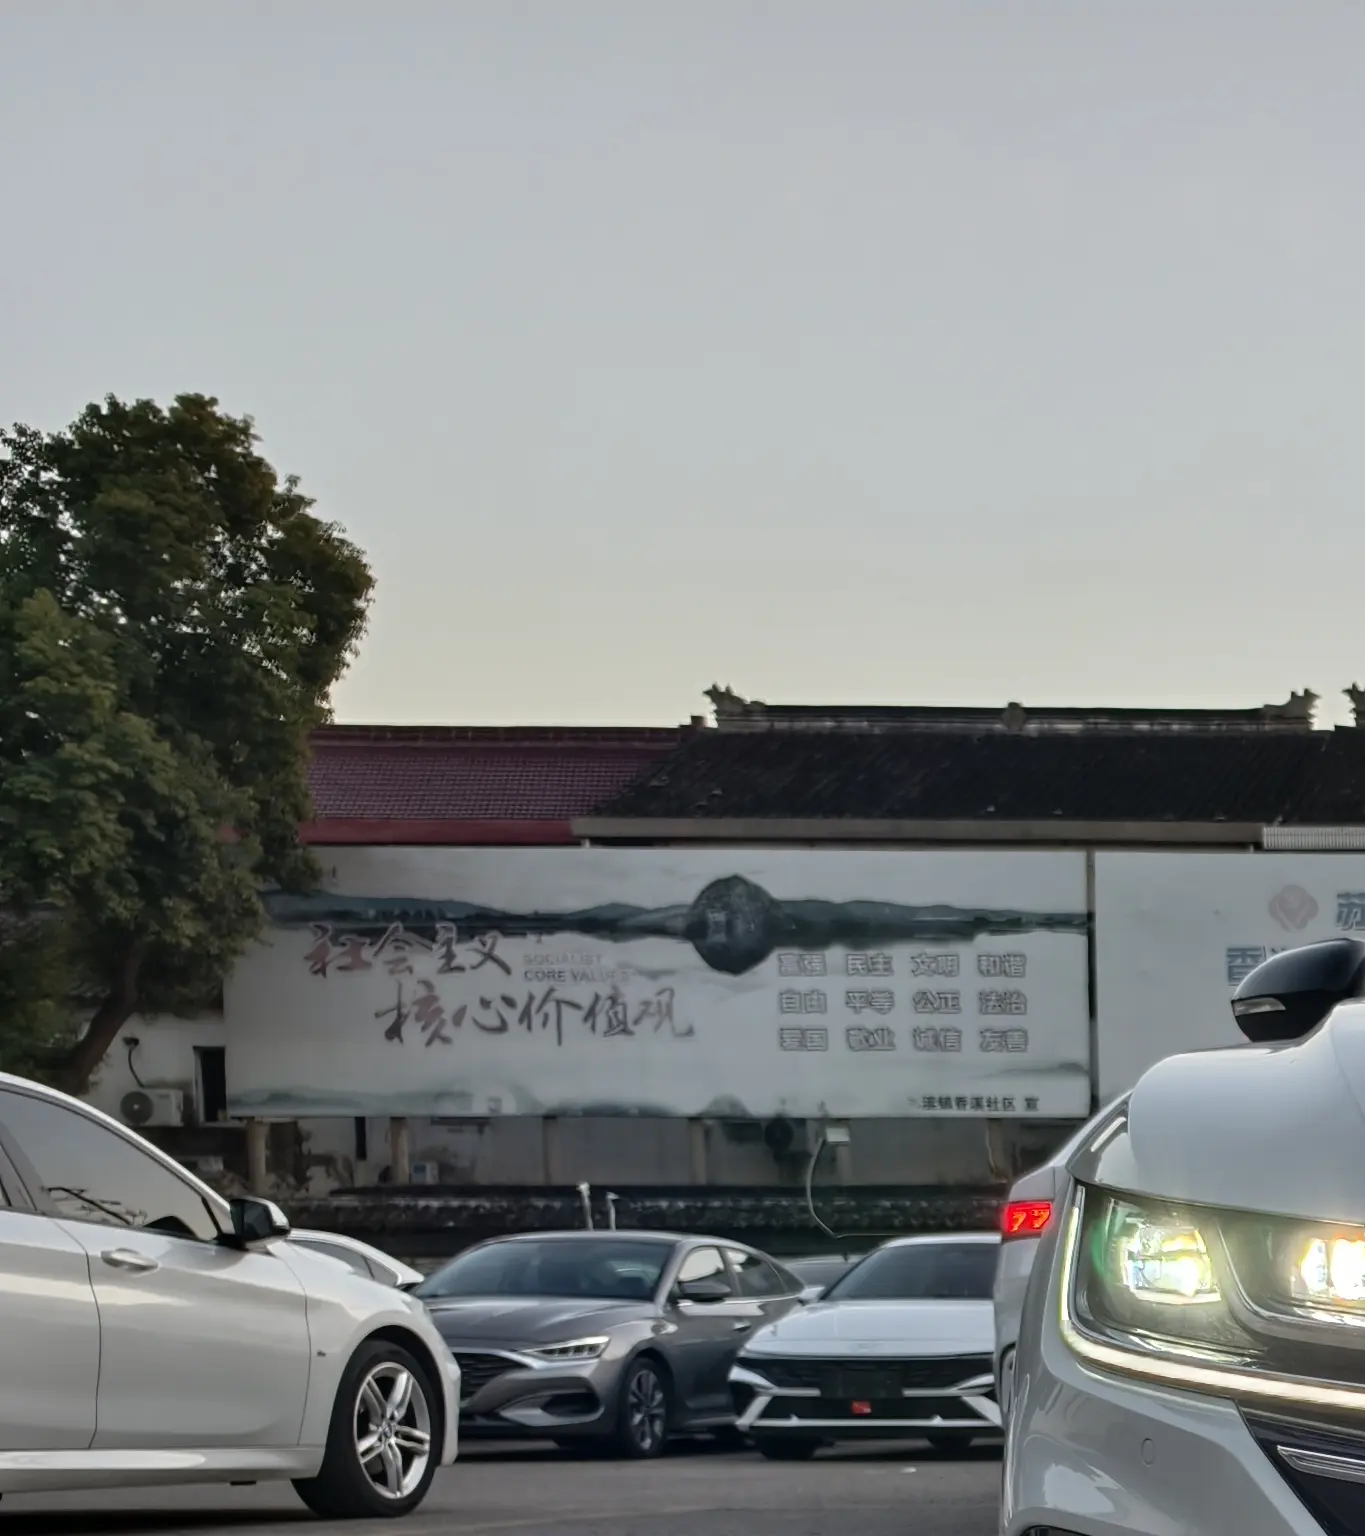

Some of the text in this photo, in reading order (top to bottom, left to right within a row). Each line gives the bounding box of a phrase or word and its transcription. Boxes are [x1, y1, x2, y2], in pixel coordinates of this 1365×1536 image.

[303, 921, 512, 978] 社会主义
[524, 970, 566, 983] CORE
[845, 952, 894, 977] 民主
[911, 952, 960, 977] 文明
[977, 952, 1027, 978] 和谐
[374, 979, 694, 1048] 核心价值观
[779, 988, 1027, 1015] 自由 平等 公正 法治
[780, 1026, 829, 1052] 爱国
[912, 1026, 962, 1052] 诚信
[979, 1027, 1029, 1052] 友善
